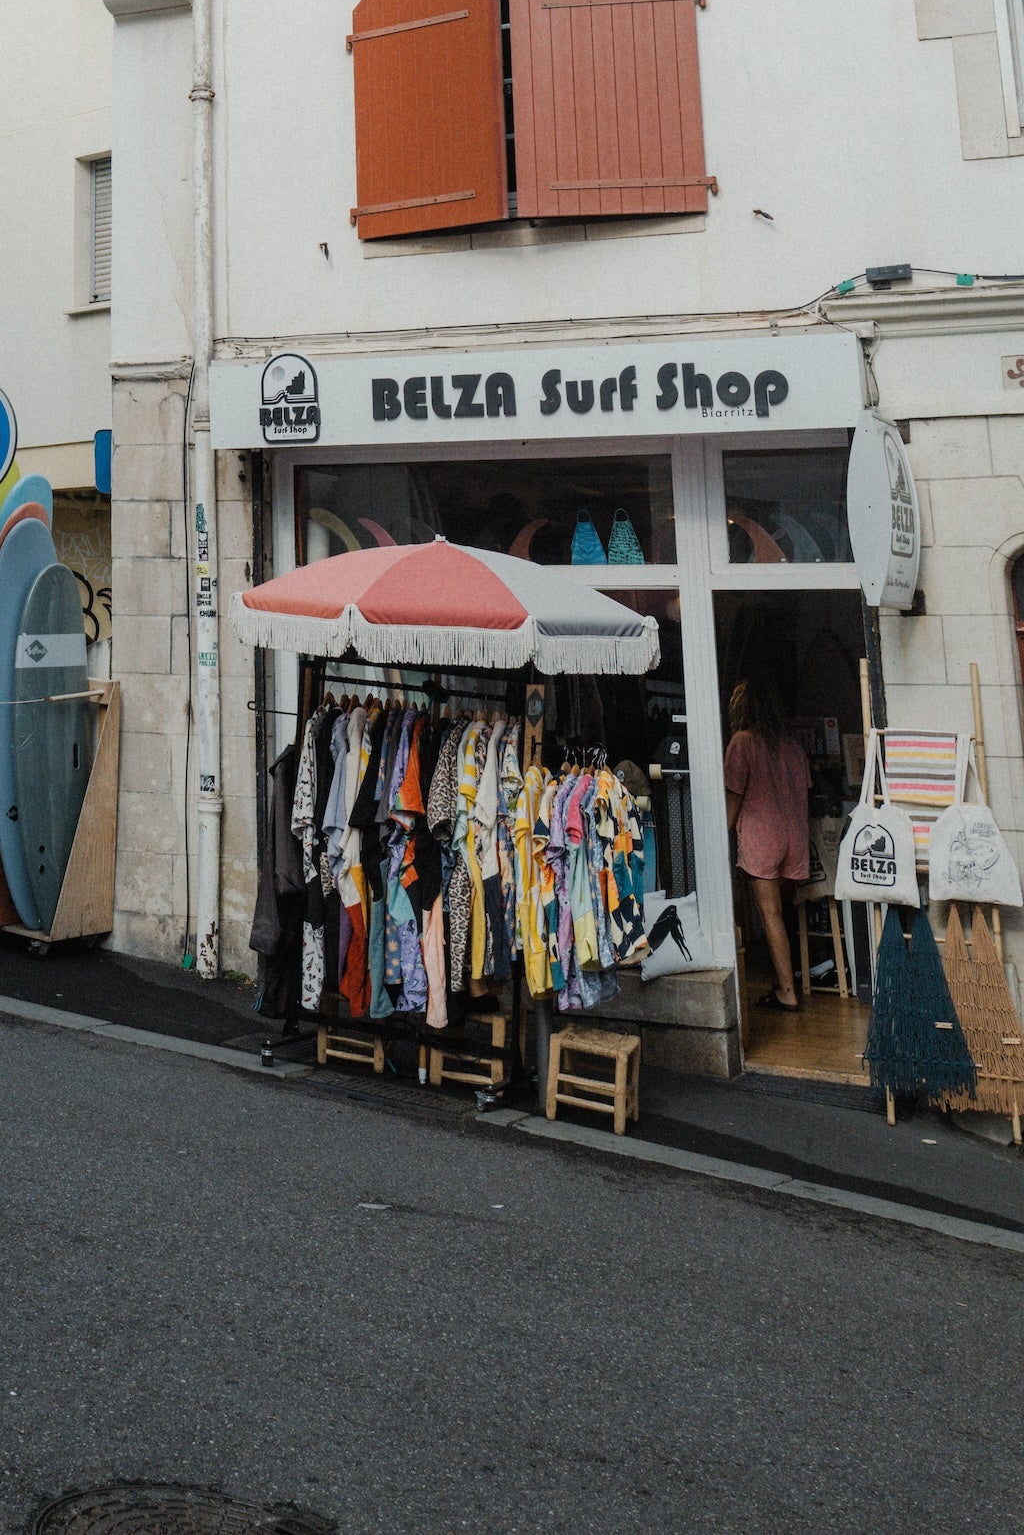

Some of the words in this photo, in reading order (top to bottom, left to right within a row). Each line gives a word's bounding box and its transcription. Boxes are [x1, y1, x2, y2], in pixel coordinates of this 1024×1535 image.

[372, 372, 517, 421] BELZA
[540, 365, 638, 415] Surf
[656, 362, 789, 418] Shop
[259, 405, 321, 427] BELZA
[702, 407, 754, 418] Biarritz
[273, 426, 287, 434] Surf
[289, 425, 308, 435] Shop
[891, 503, 915, 534] BELZA
[850, 856, 897, 875] BELZA
